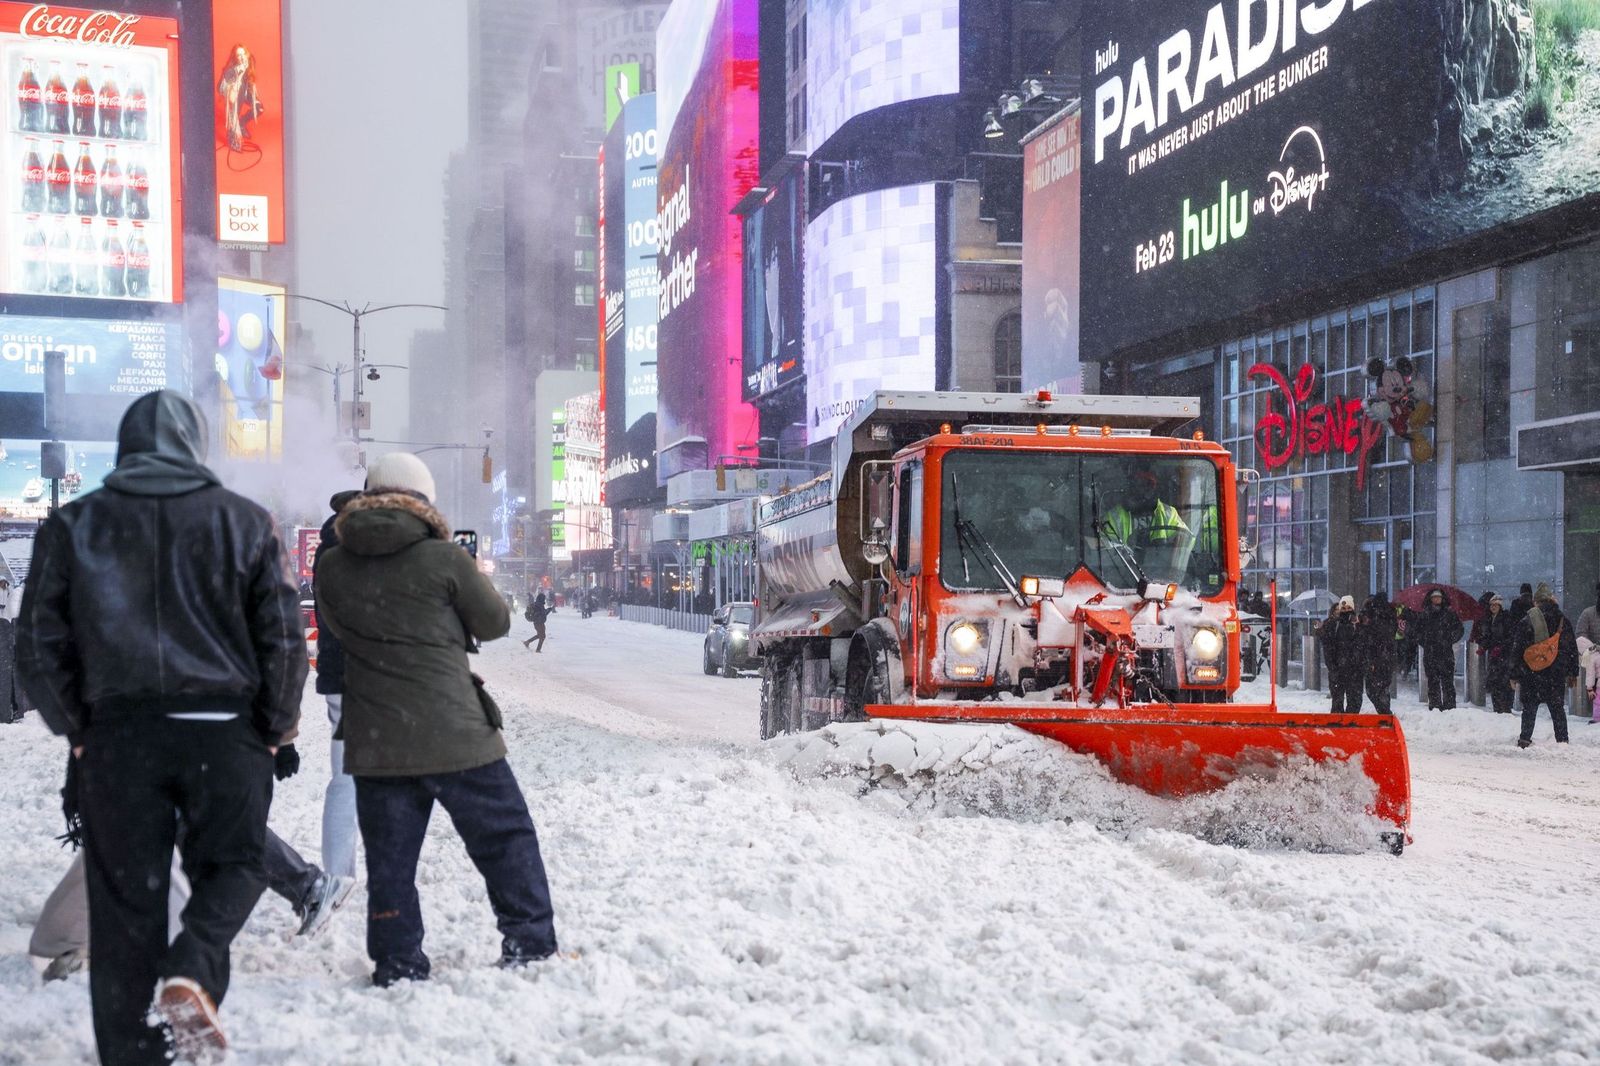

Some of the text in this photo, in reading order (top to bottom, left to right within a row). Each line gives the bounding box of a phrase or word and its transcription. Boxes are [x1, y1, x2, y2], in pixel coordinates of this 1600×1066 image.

[1095, 40, 1119, 75] hulu
[1094, 0, 1371, 164] PARADI
[1128, 46, 1328, 175] IT WAS NEVER JUST ABOUT THE BUNKER
[229, 203, 258, 218] brit
[229, 218, 260, 231] box
[1136, 179, 1265, 273] Feb 23 hulu ON
[108, 325, 166, 334] KEFALONIA
[128, 335, 166, 343] ITHACA
[132, 343, 166, 351] ZANTE
[132, 351, 166, 360] CORFU
[143, 360, 166, 369] PAXI
[120, 368, 166, 377] LEFKADA
[117, 377, 166, 385] MEGANISI
